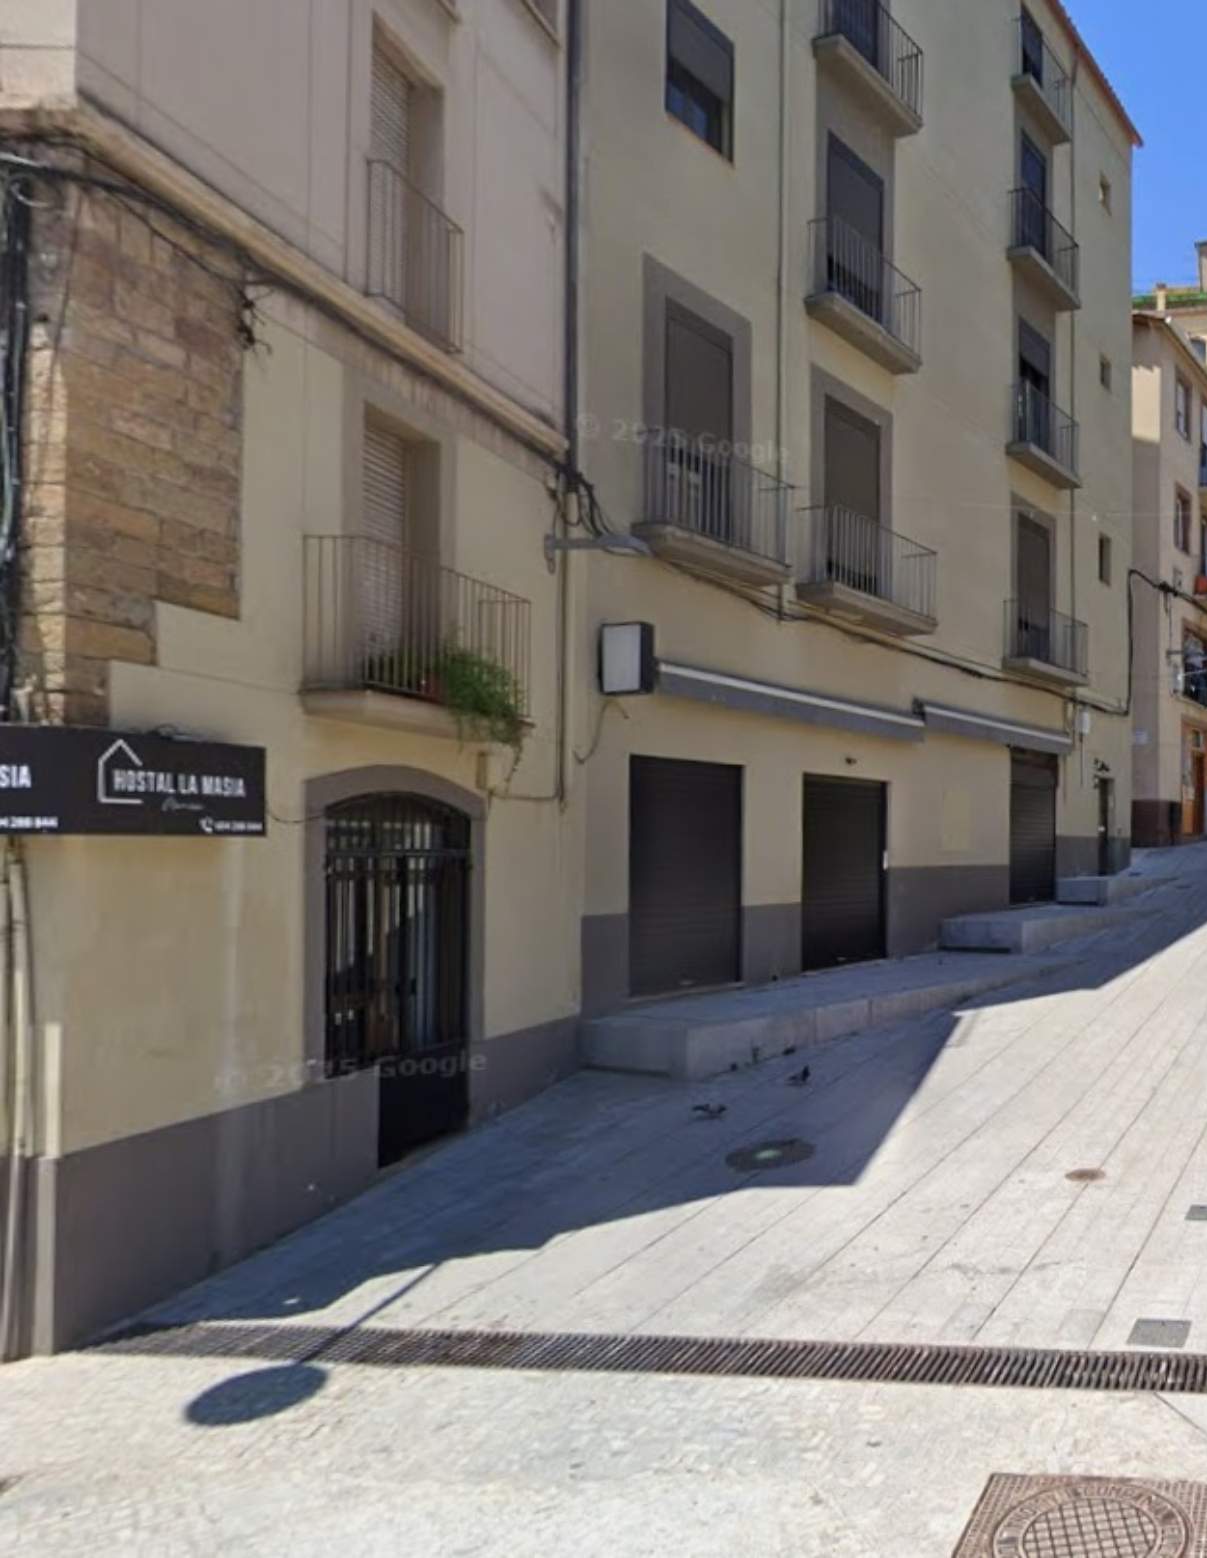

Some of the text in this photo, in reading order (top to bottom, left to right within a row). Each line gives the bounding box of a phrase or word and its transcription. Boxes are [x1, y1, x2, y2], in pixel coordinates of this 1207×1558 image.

[113, 769, 246, 797] HOSTAL LA MASIA
